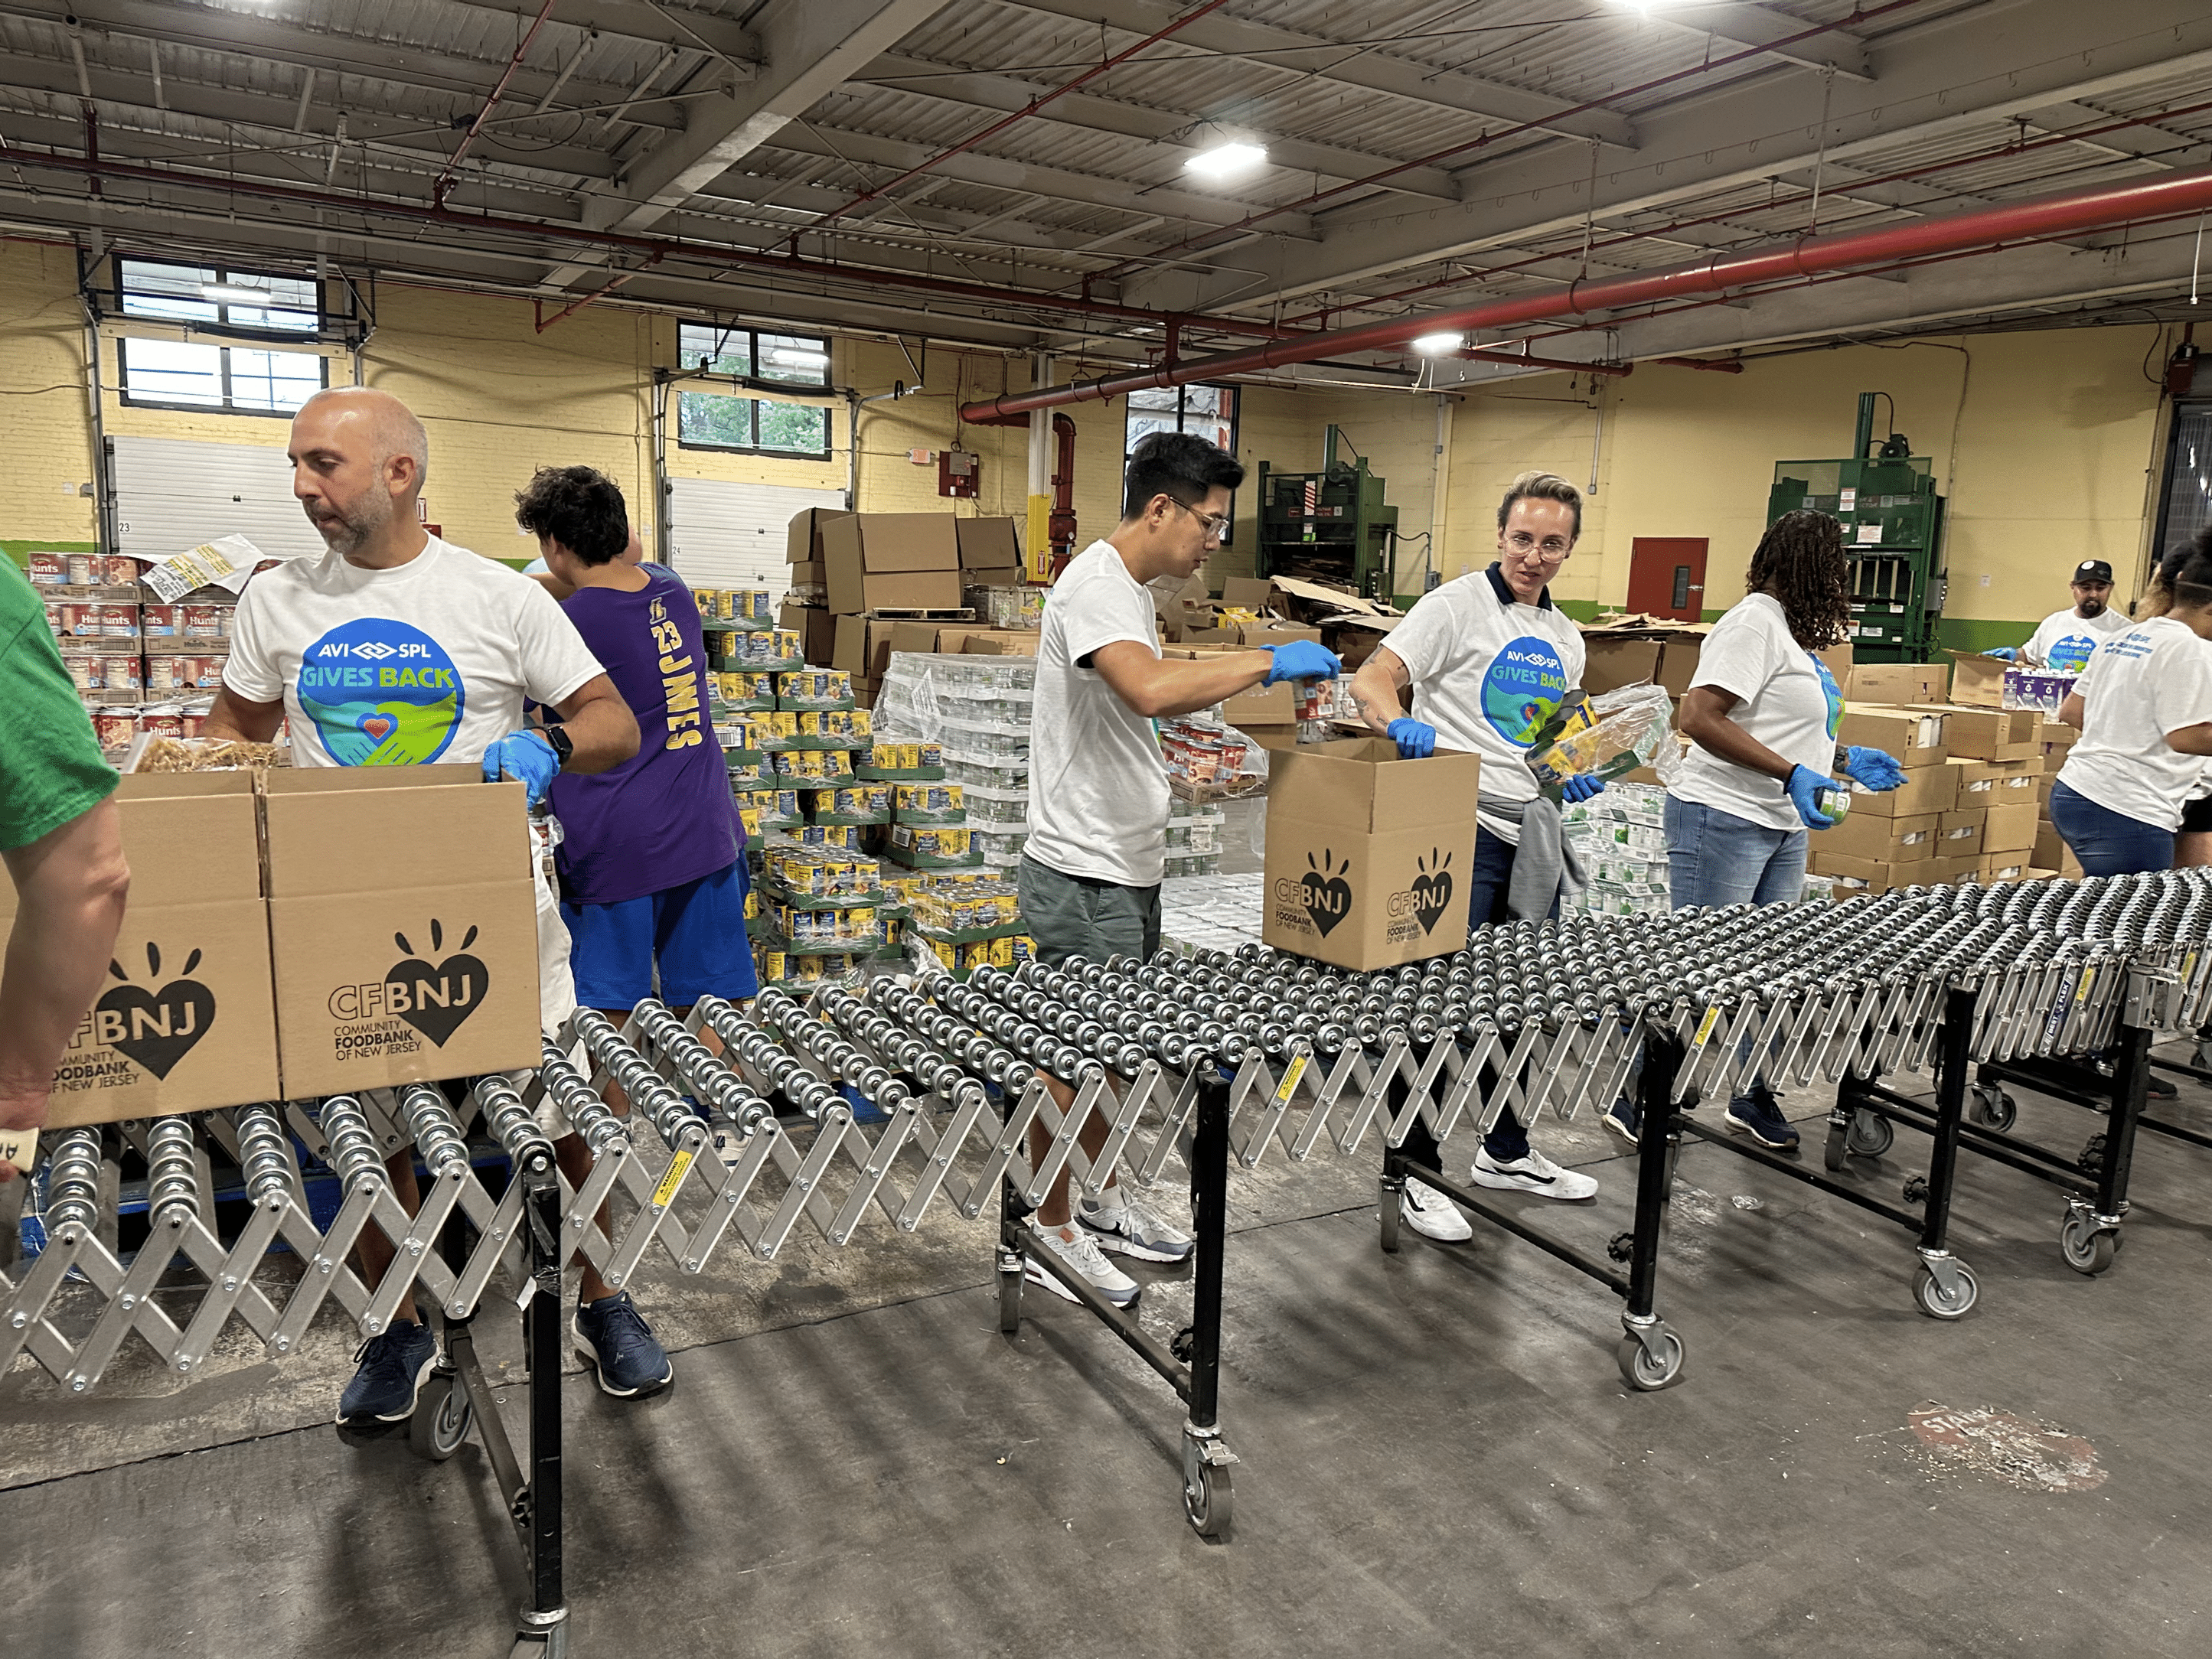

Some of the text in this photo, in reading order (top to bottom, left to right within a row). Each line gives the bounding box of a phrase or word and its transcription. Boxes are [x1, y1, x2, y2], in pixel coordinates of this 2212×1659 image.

[119, 523, 129, 532] 23
[673, 546, 680, 555] 24
[651, 620, 683, 655] 23
[318, 643, 432, 658] AVI SPL
[1506, 650, 1525, 663] AVI
[302, 667, 455, 688] GIVES BACK
[1491, 665, 1538, 685] GIVES
[659, 655, 703, 751] JAMES
[1274, 877, 1343, 915] CFBNJ
[1386, 885, 1447, 918] CFBNJ
[1275, 911, 1313, 926] FOODBANK
[1284, 921, 1297, 931] NEW
[328, 973, 472, 1021] CFBNJ
[2058, 983, 2070, 1004] FLEX
[67, 1000, 197, 1048] FBNJ
[334, 1019, 402, 1037] COMMUNITY
[334, 1029, 413, 1051] FOODBANK
[60, 1050, 116, 1066] MMUNITY
[335, 1041, 422, 1061] OF NEW JERSEY
[61, 1079, 94, 1094] NEW
[98, 1073, 141, 1089] JERSEY
[661, 1161, 679, 1188] WARNING
